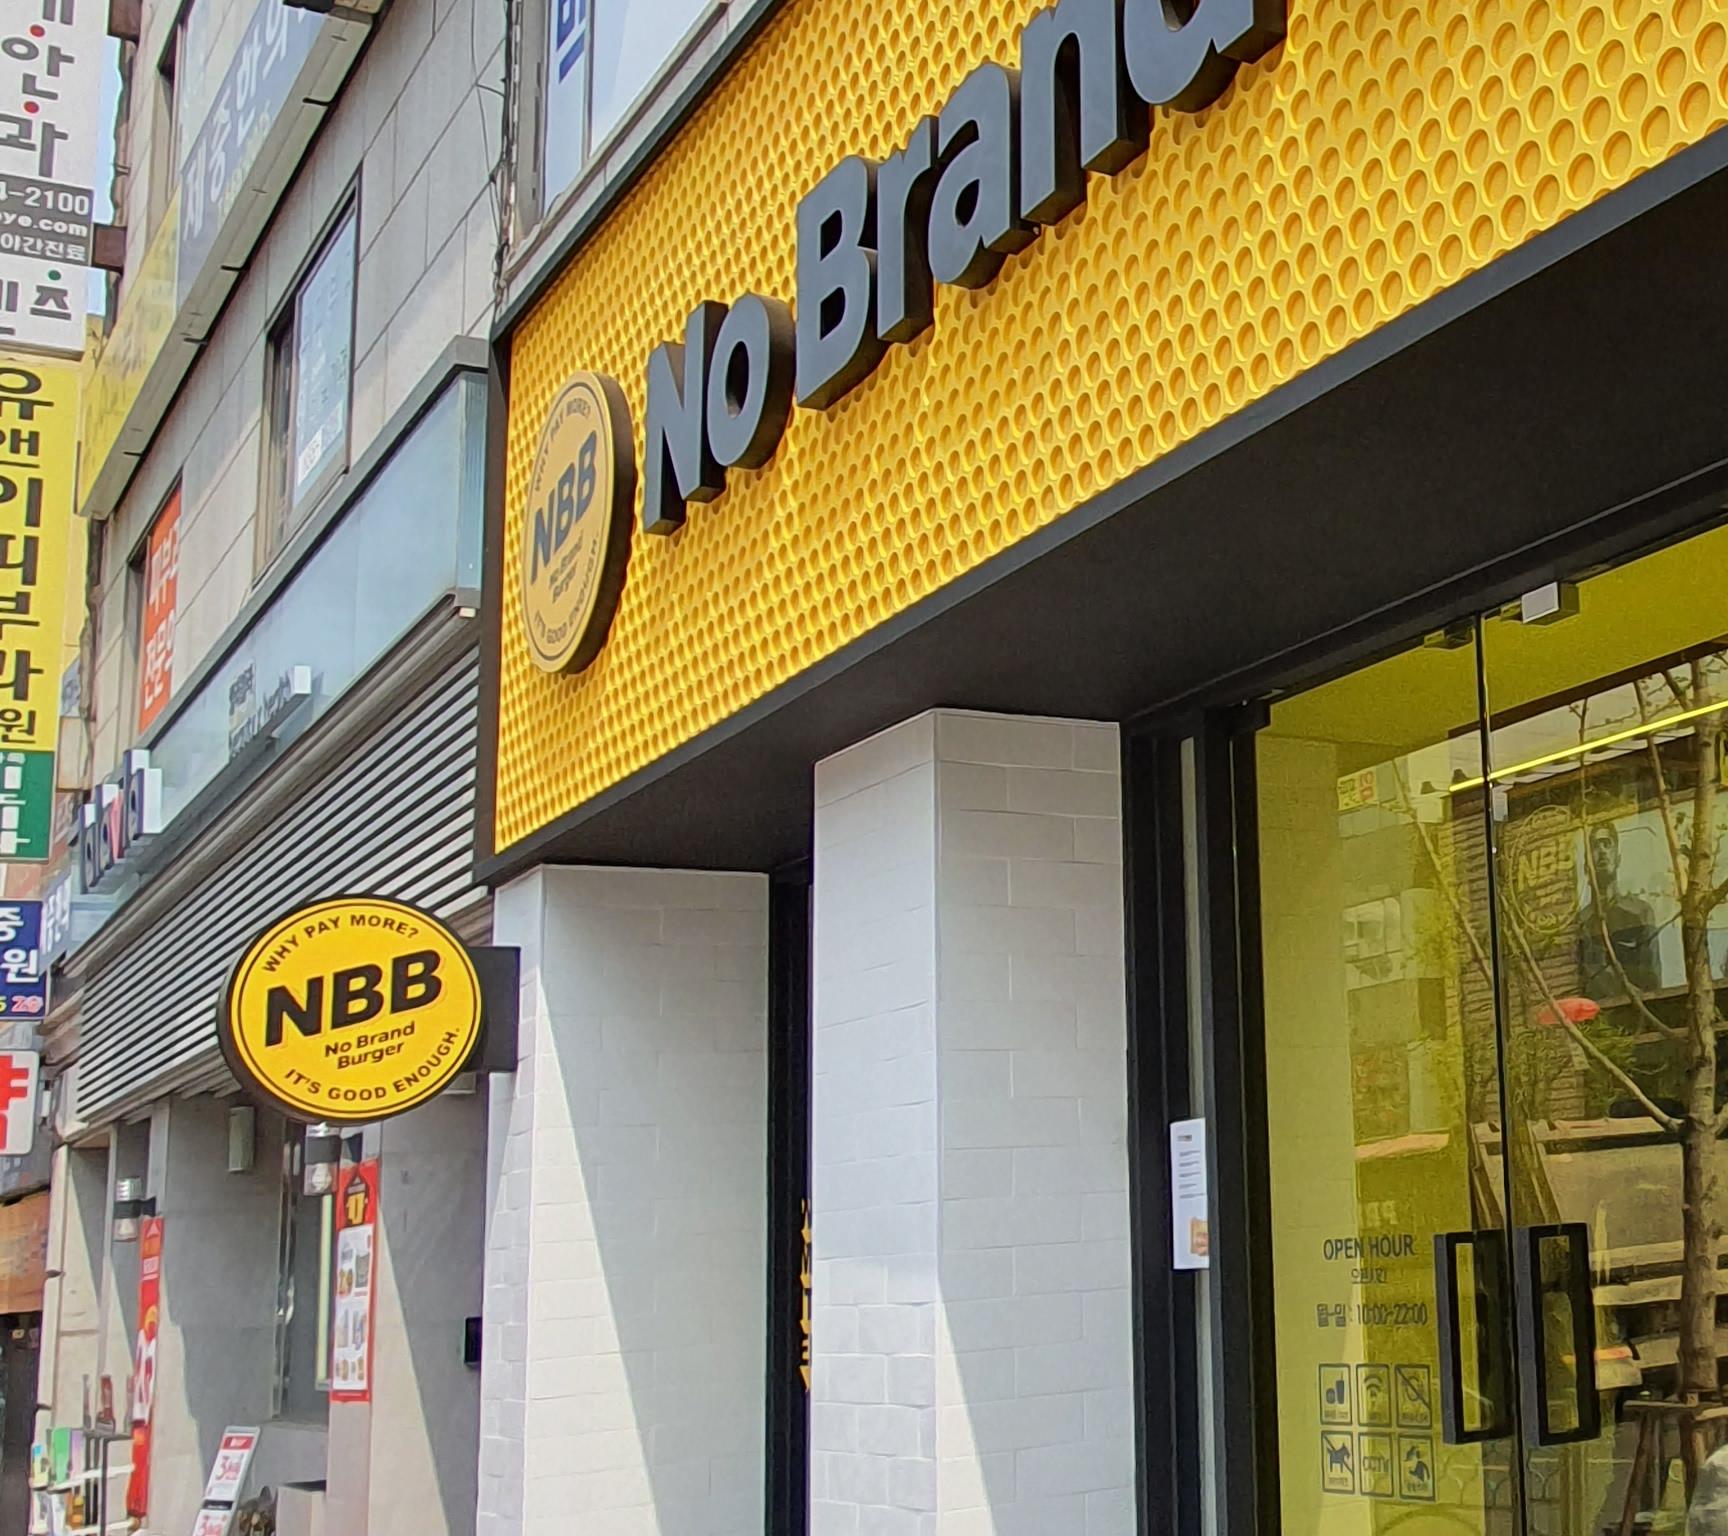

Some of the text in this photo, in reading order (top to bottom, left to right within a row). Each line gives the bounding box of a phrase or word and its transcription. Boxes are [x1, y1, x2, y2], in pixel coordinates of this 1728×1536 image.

[0, 212, 88, 237] ye.com
[1, 233, 86, 262] 야간진료
[644, 292, 795, 535] No
[531, 430, 597, 586] NBB
[262, 914, 419, 973] WHY PAY MORE?
[265, 949, 443, 1047] NBB
[324, 1020, 416, 1058] No Brand
[337, 1041, 404, 1070] Burger
[284, 1027, 460, 1102] IT'S GOOD ENOUGH.
[1323, 1233, 1416, 1260] OPEN HOUR
